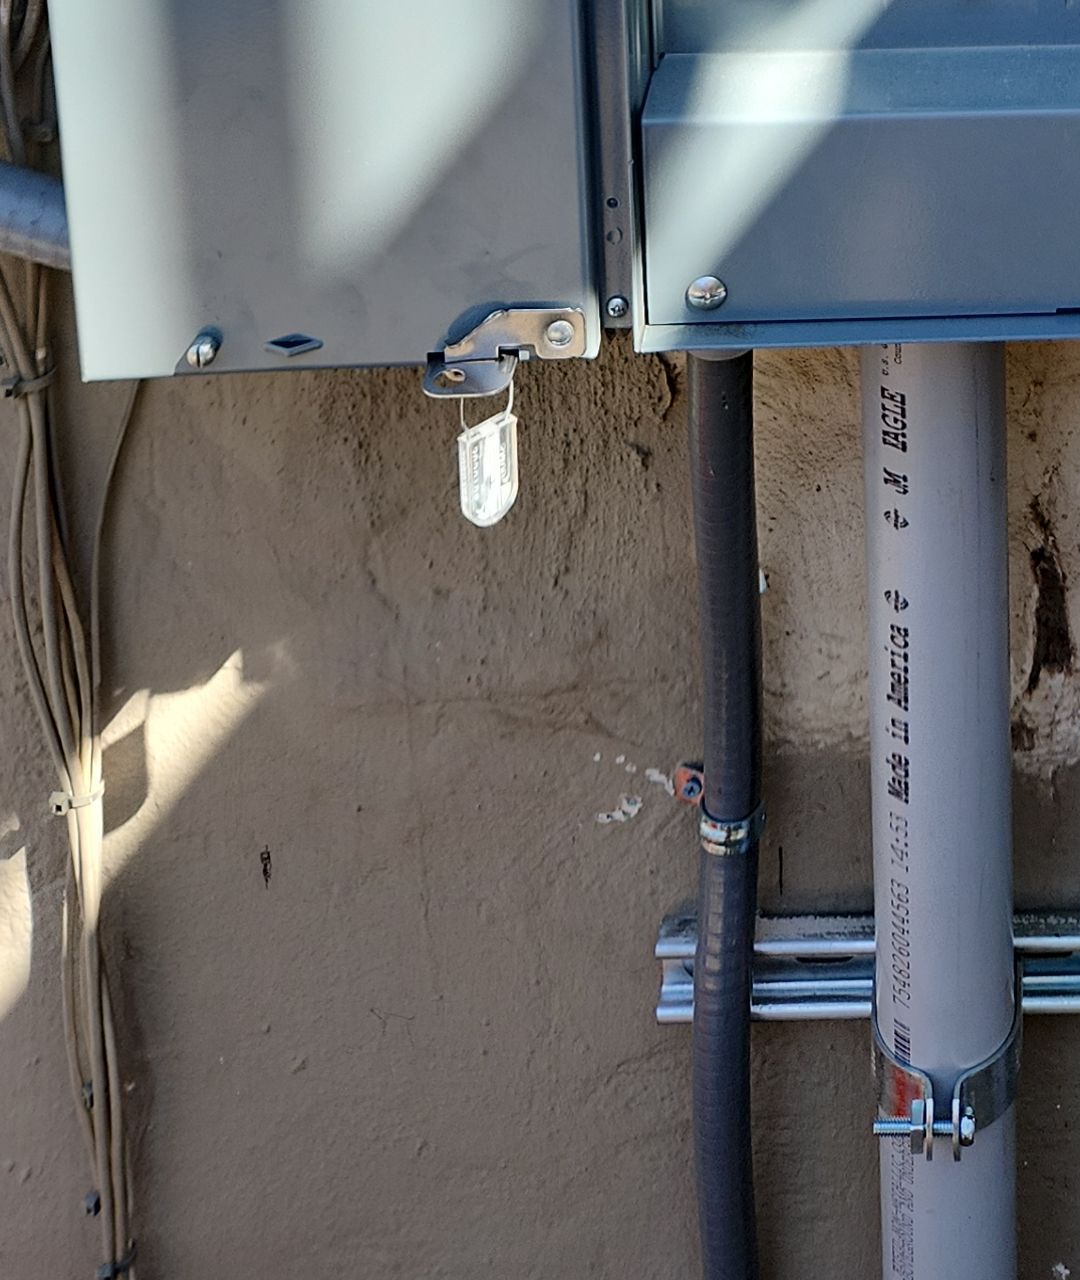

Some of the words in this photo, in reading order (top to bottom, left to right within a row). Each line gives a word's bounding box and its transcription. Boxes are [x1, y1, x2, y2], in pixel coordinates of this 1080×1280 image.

[881, 385, 907, 453] EAGLE
[884, 624, 909, 711] America
[885, 718, 909, 745] in
[886, 752, 909, 804] Made
